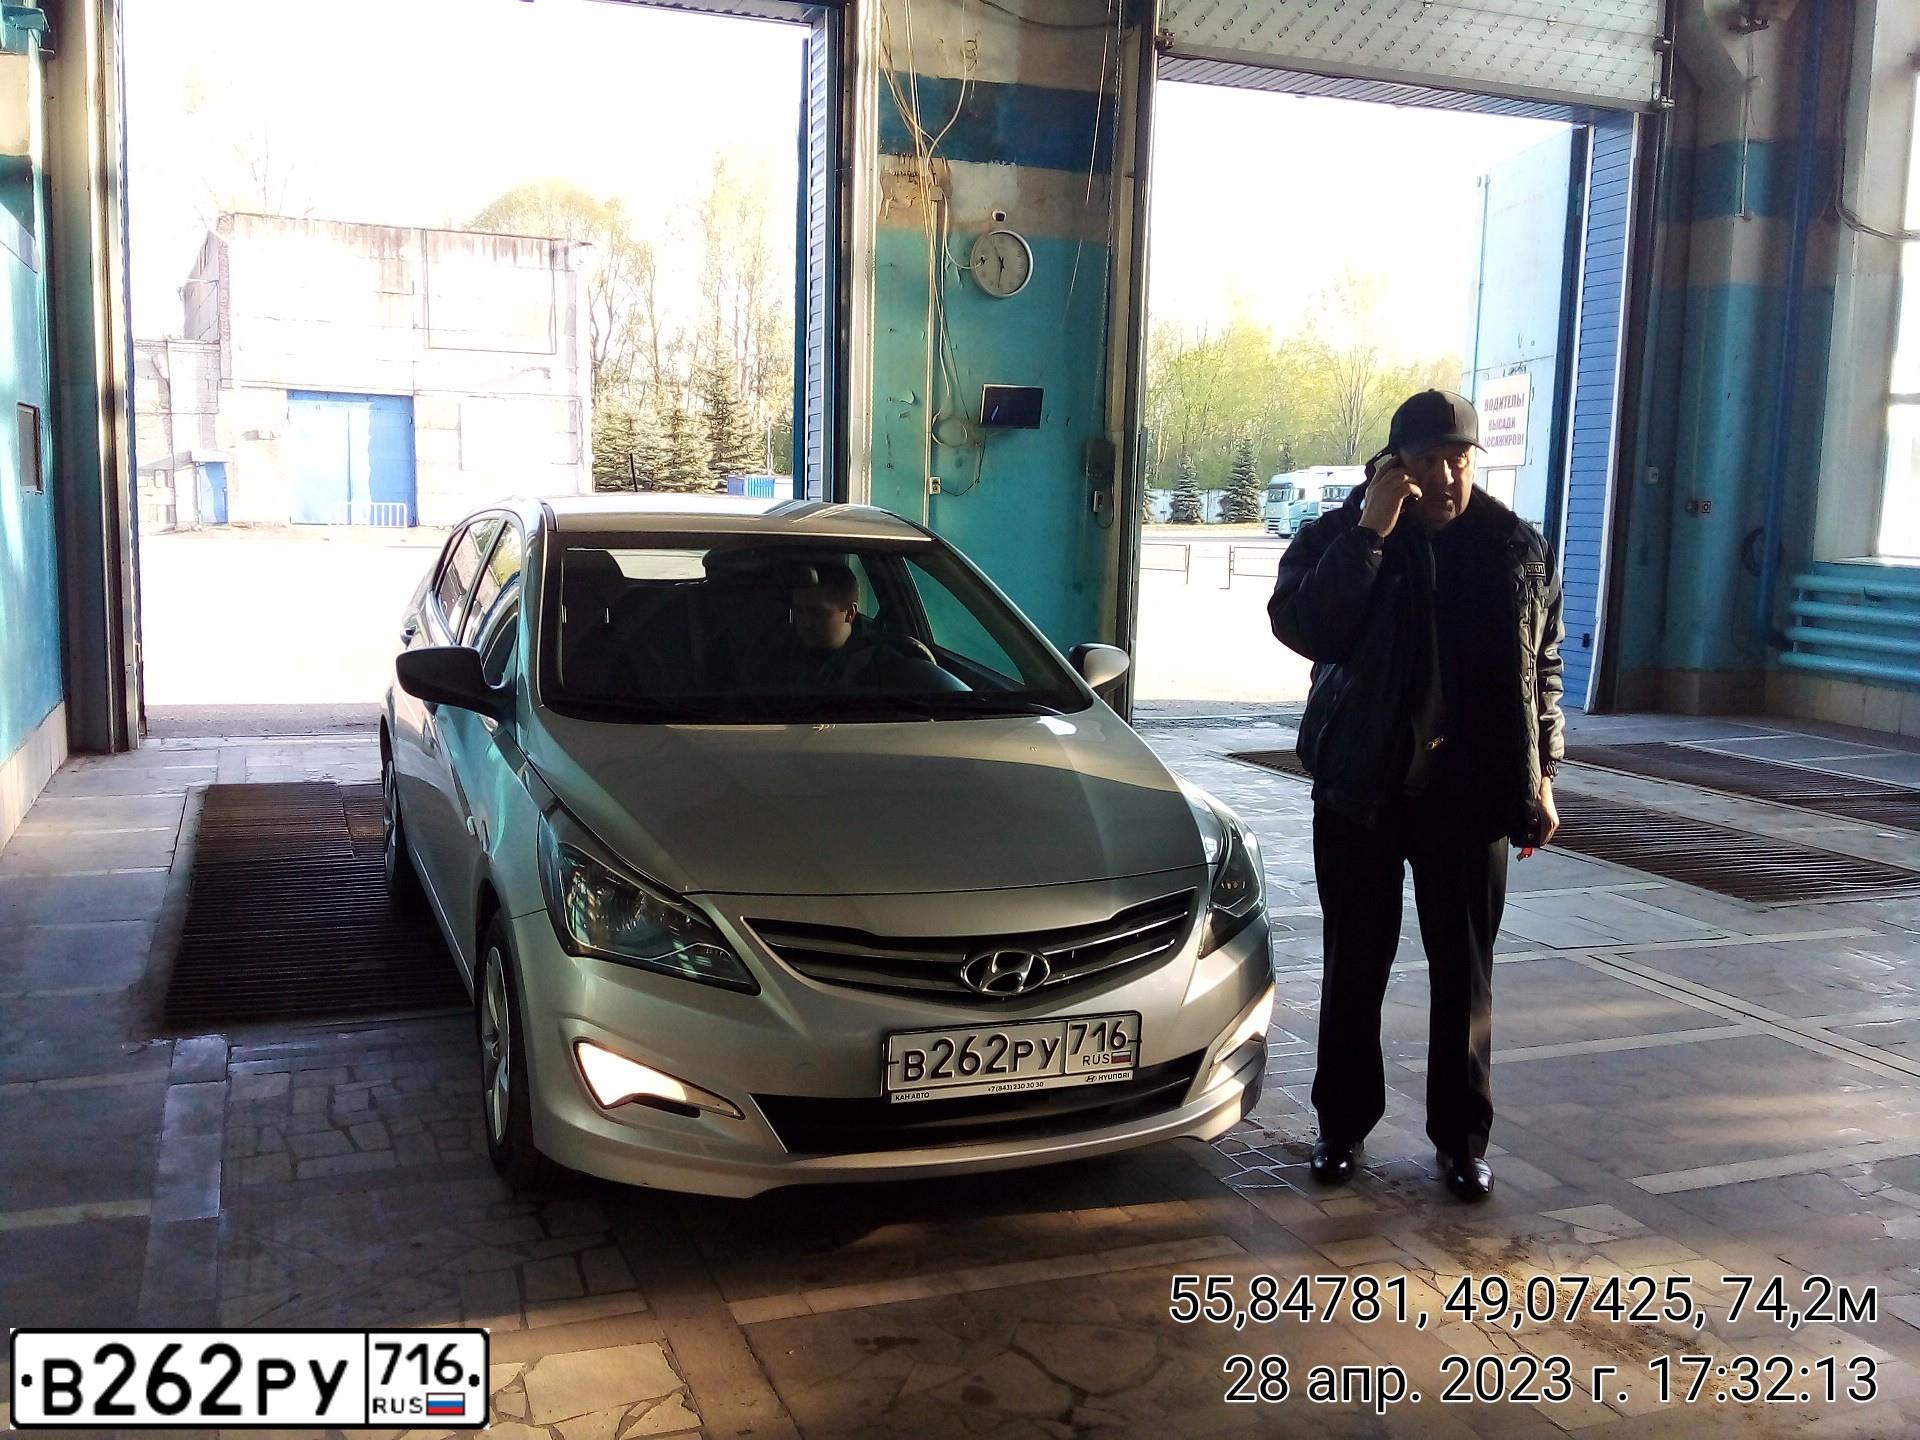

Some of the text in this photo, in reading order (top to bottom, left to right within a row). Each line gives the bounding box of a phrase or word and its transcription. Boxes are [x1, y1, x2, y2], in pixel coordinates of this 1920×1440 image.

[1488, 417, 1516, 431] ВЫСАДИ
[904, 1020, 1128, 1082] В262РУ 716
[1082, 1053, 1110, 1067] RUS
[1098, 1072, 1130, 1081] HYUNDAI
